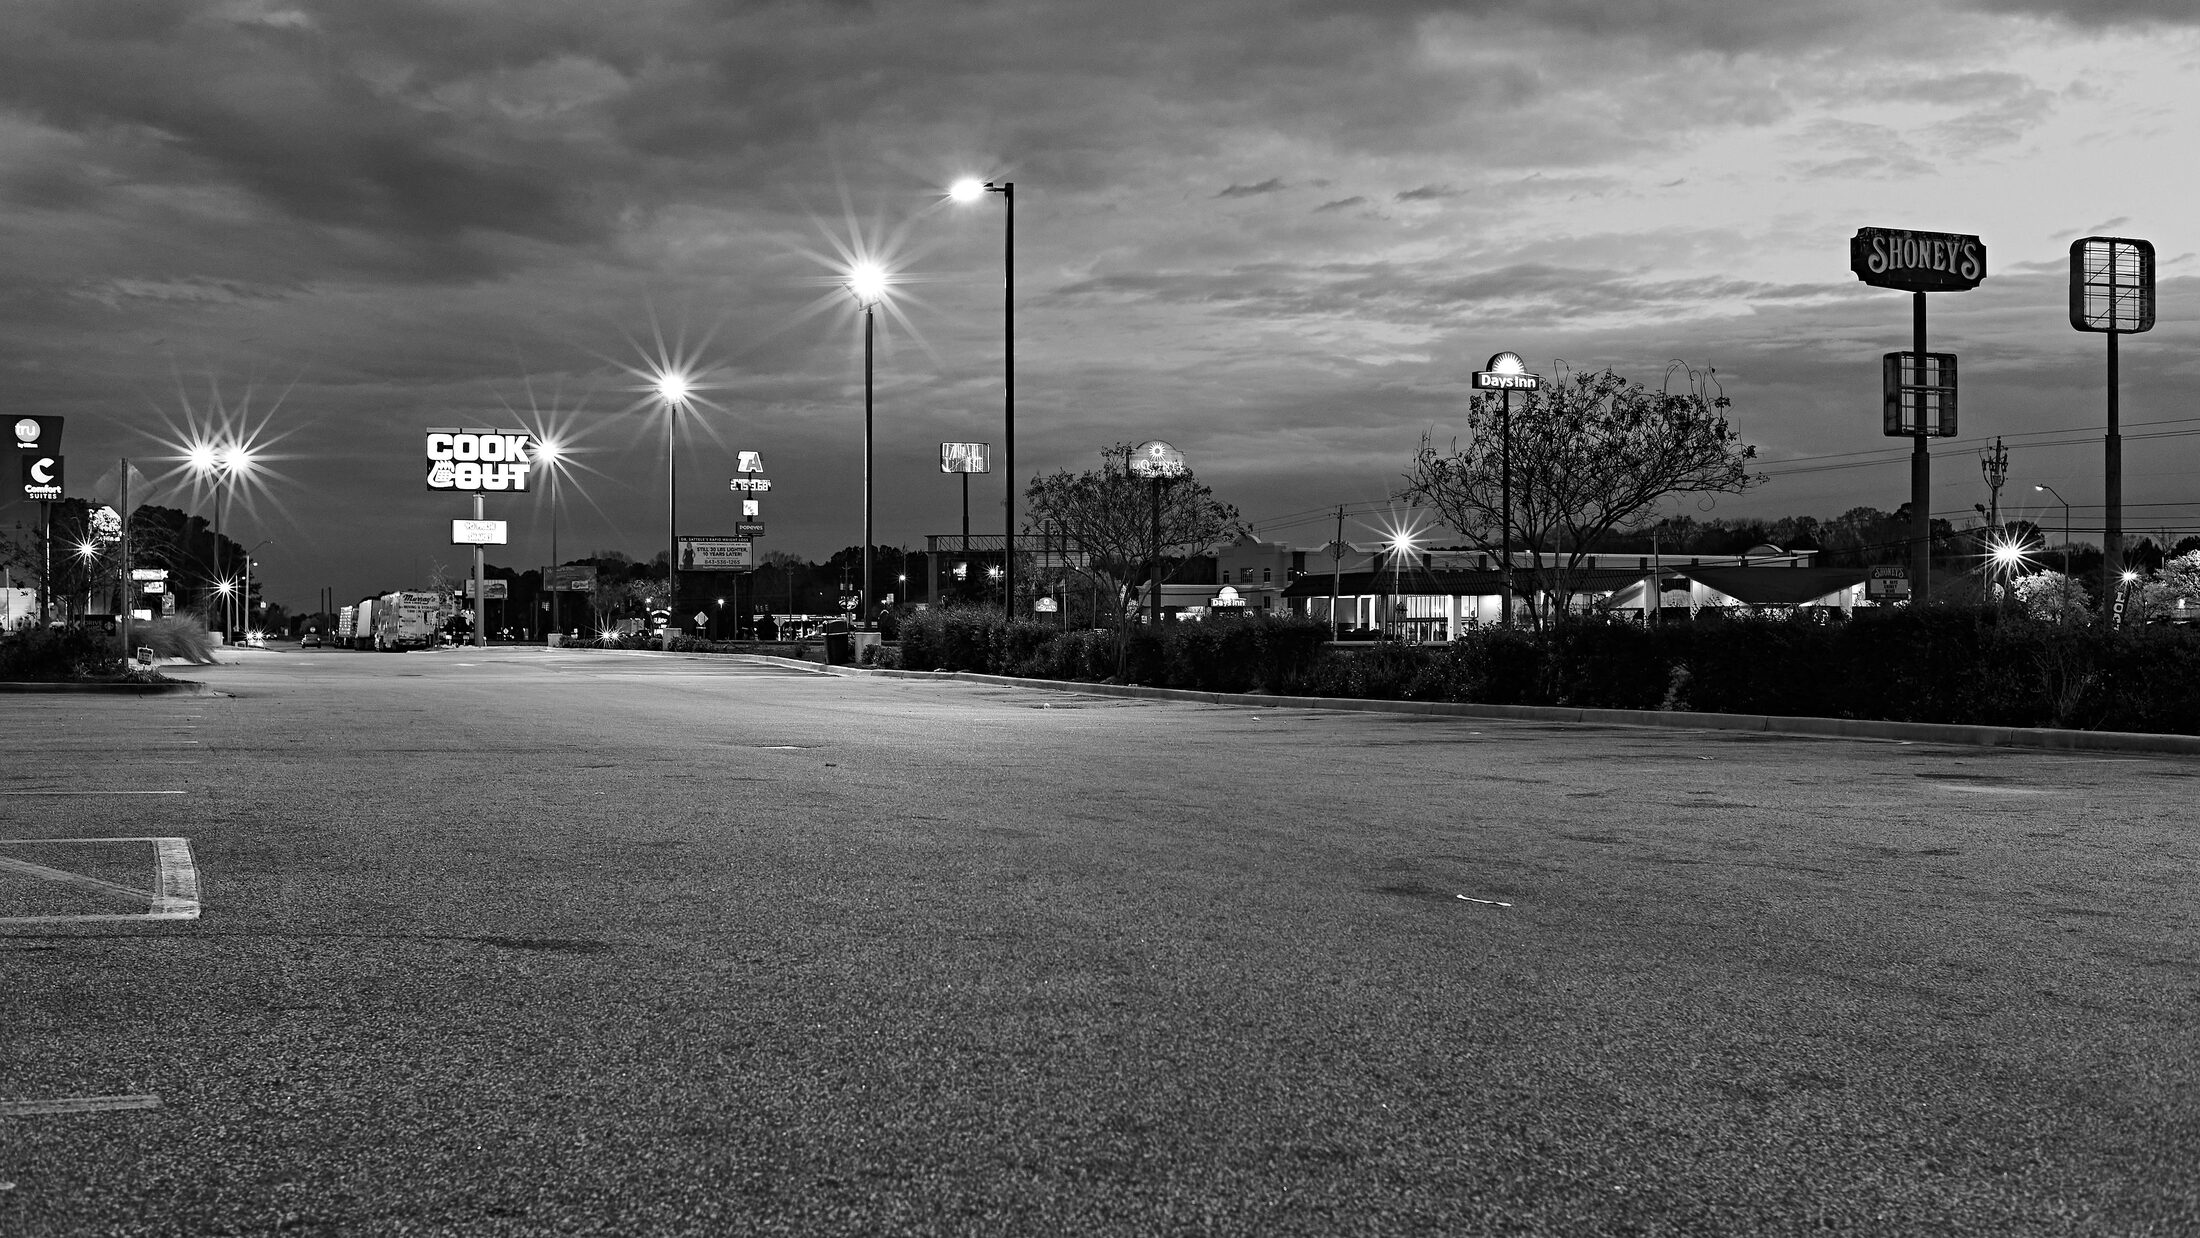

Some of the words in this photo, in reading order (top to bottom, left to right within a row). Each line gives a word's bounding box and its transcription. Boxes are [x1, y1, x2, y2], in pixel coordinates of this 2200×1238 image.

[1868, 236, 1982, 280] SHONEY'S
[1481, 374, 1514, 388] Days
[1515, 376, 1536, 388] Inn
[427, 433, 530, 462] COOK
[455, 462, 530, 490] OUT
[24, 484, 62, 494] Comfort
[1212, 599, 1232, 607] Days
[1232, 599, 1245, 607] Inn
